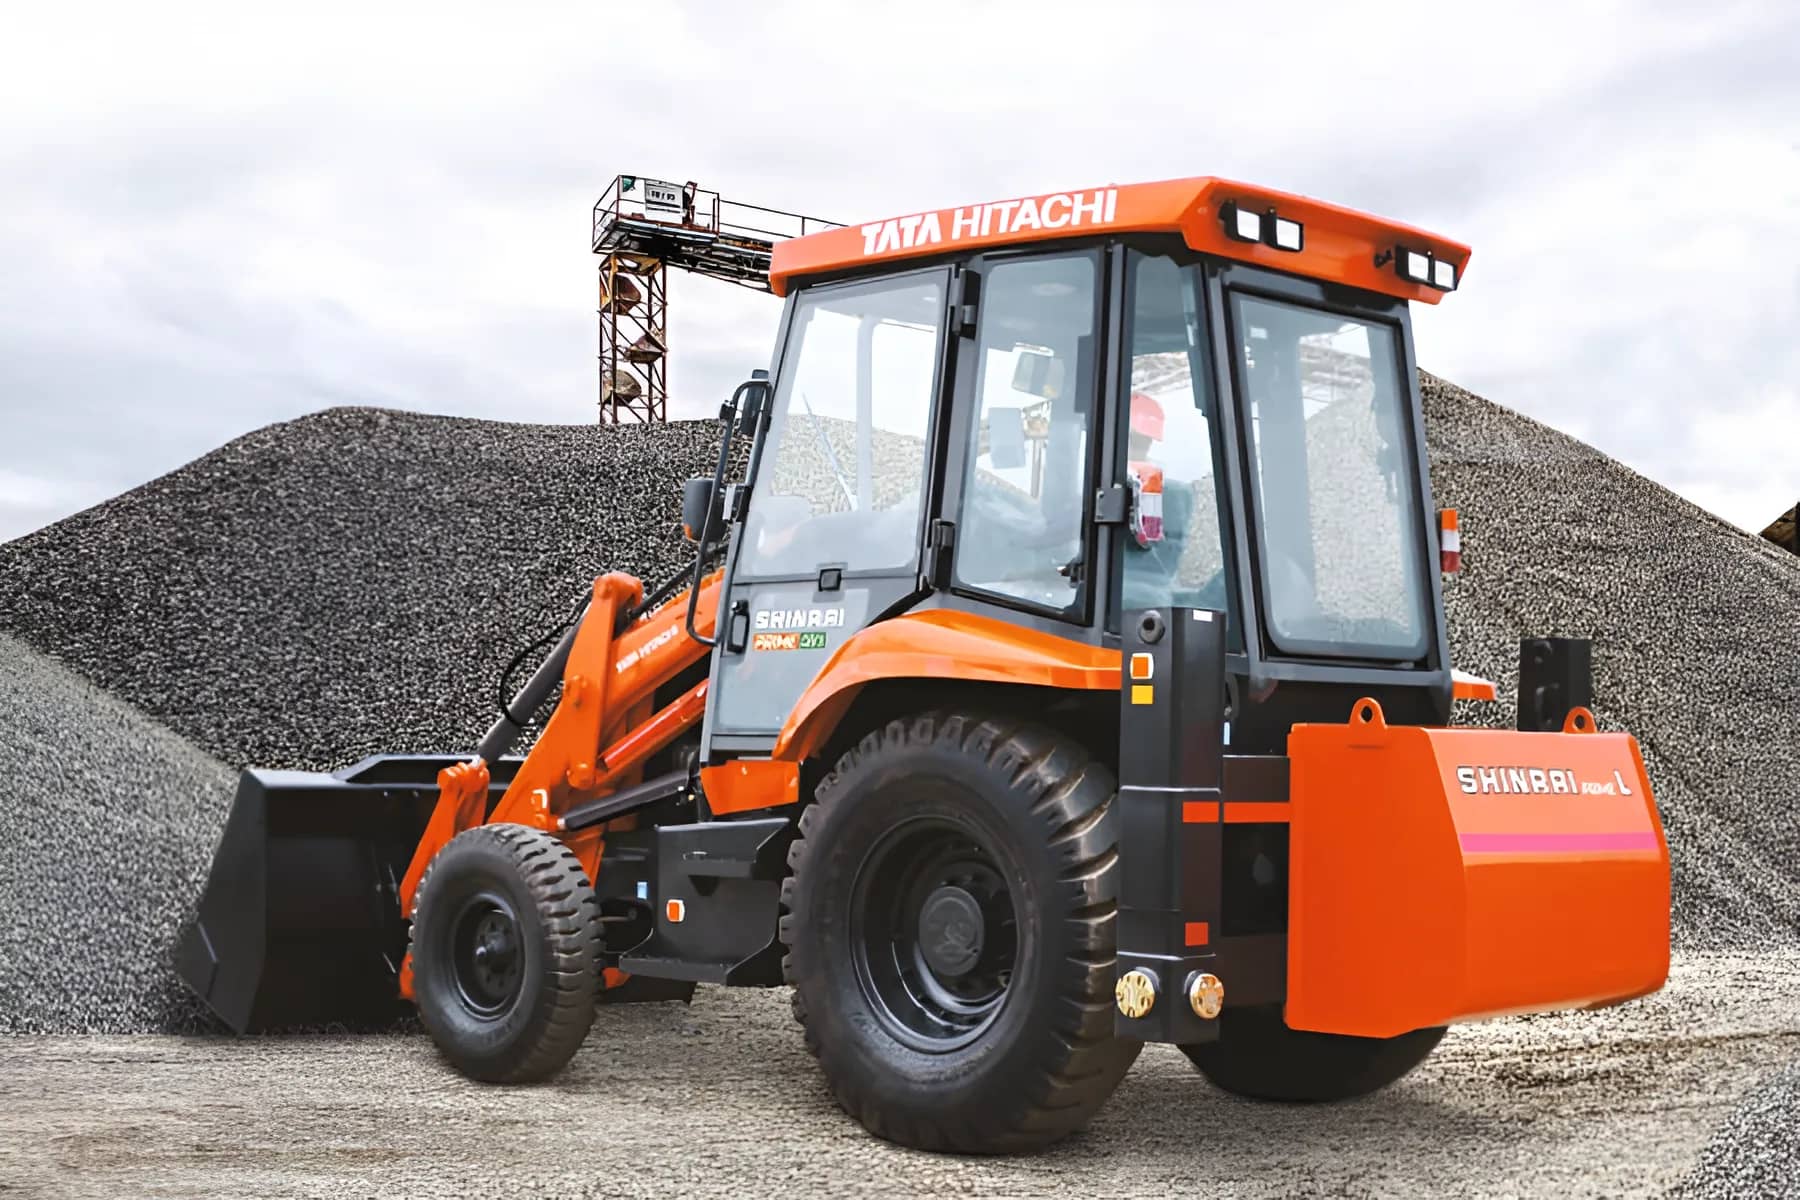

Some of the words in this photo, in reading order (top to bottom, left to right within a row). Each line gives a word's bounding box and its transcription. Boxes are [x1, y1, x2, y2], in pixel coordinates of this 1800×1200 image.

[861, 213, 942, 256] TATA
[951, 189, 1118, 241] HITACHI
[1613, 769, 1632, 797] L
